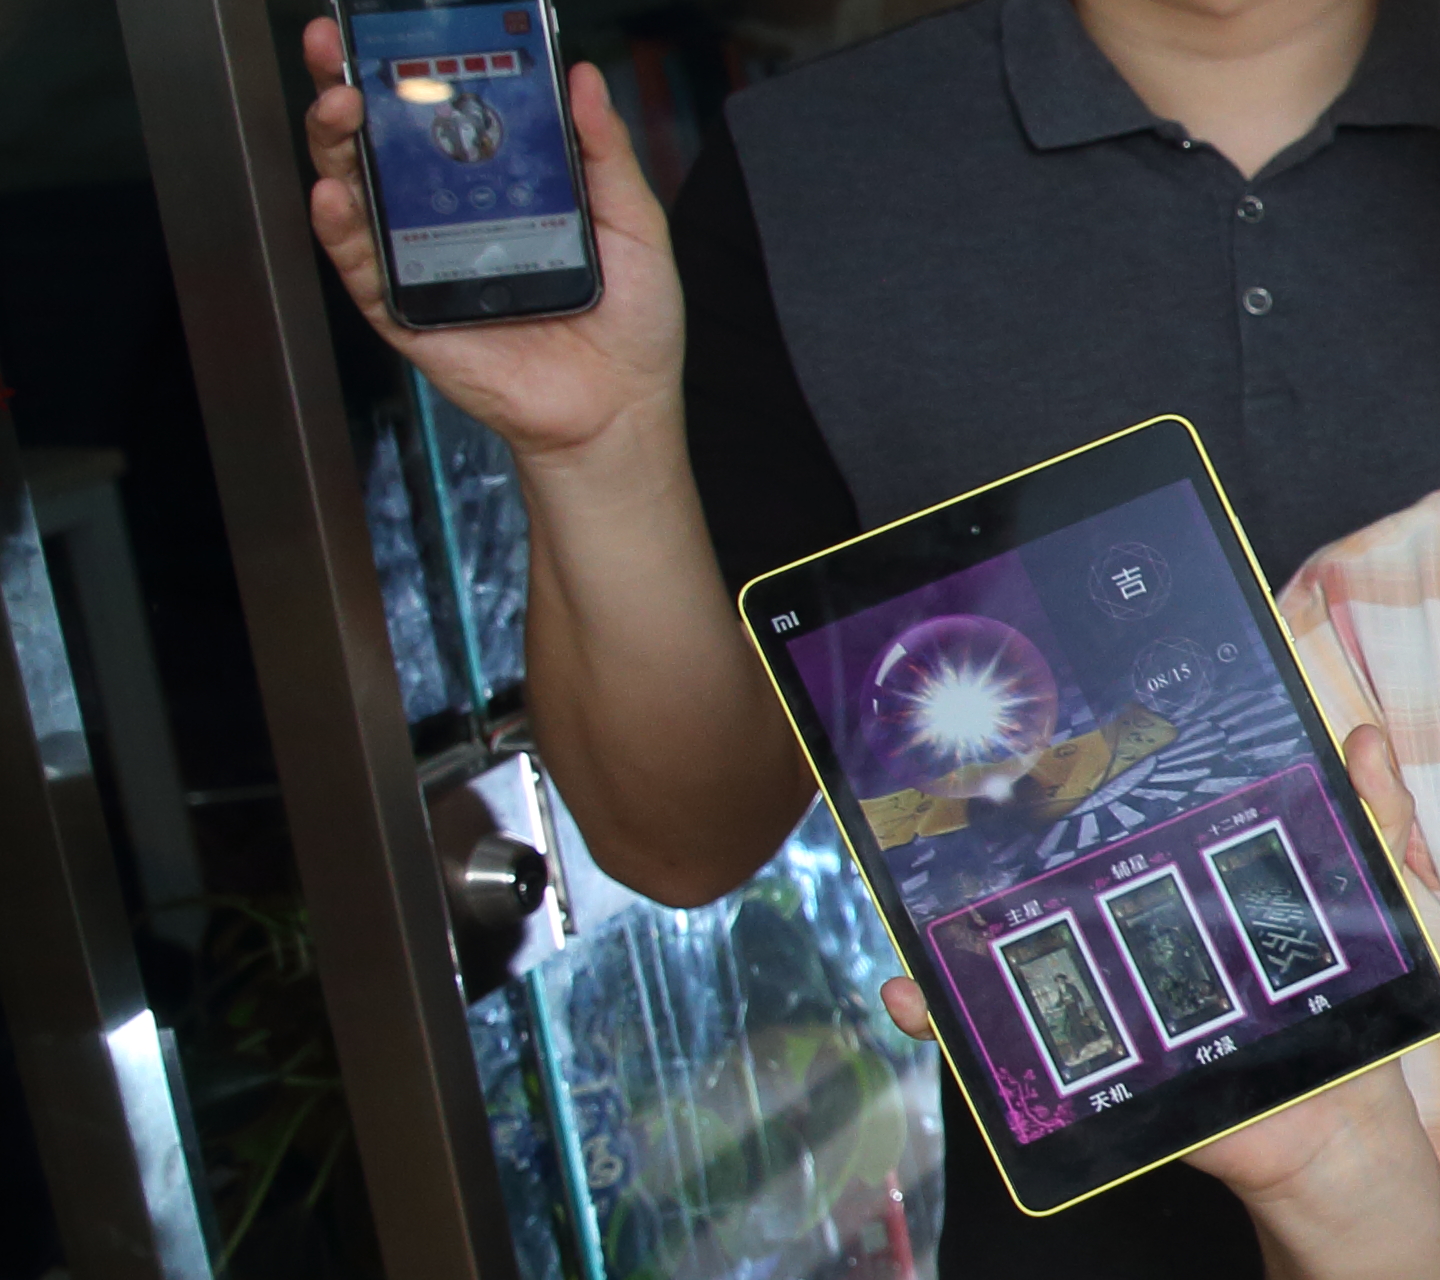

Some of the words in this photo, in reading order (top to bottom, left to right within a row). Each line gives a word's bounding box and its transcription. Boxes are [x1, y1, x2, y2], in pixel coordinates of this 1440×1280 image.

[1111, 566, 1148, 600] 吉
[1147, 663, 1192, 692] 08/15
[1004, 900, 1044, 928] 主星
[1089, 1084, 1133, 1113] 天机
